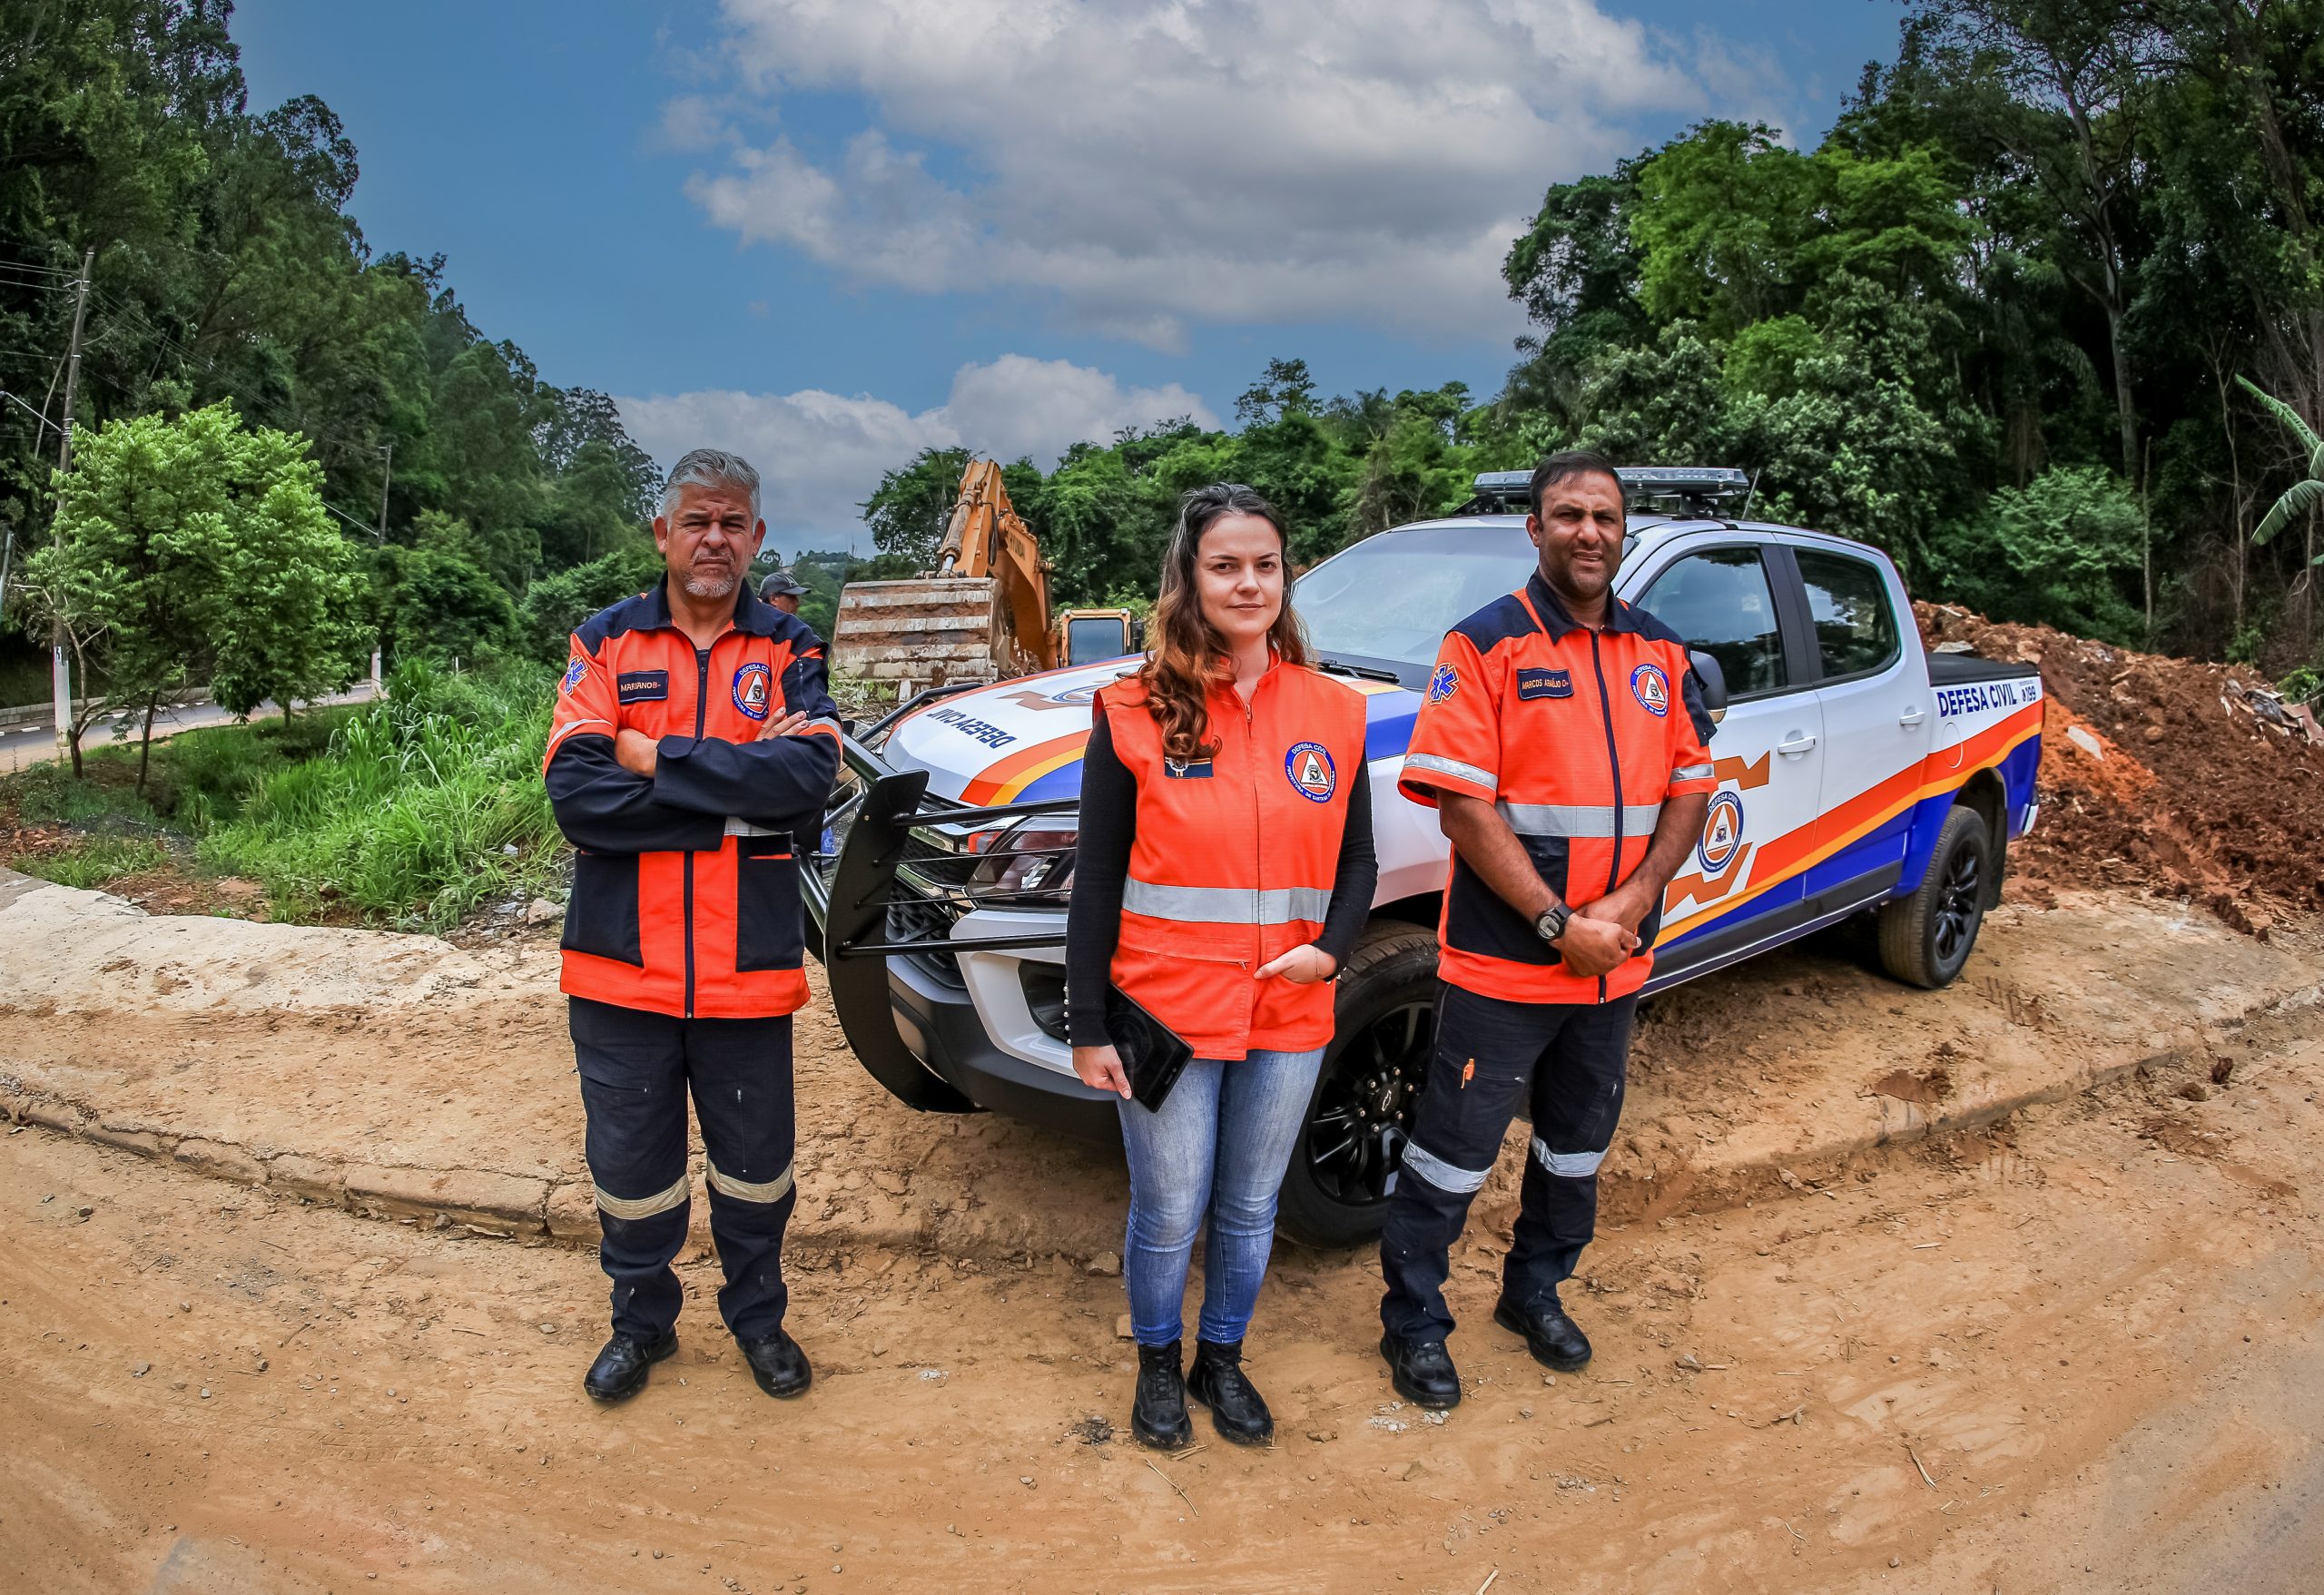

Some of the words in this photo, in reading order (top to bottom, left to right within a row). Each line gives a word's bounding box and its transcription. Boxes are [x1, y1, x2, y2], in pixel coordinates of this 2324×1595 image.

[739, 664, 761, 675] DEFESA
[1634, 665, 1652, 675] DEFESA
[620, 682, 652, 693] MARIANO
[1521, 678, 1543, 691] MARCOS
[1936, 687, 1990, 718] DEFESA
[1989, 683, 2017, 709] CIVIL
[1291, 743, 1314, 754] DEFESA
[1313, 744, 1327, 757] CIVIL
[1708, 793, 1728, 813] DEFESA
[1728, 793, 1739, 807] CIVIL
